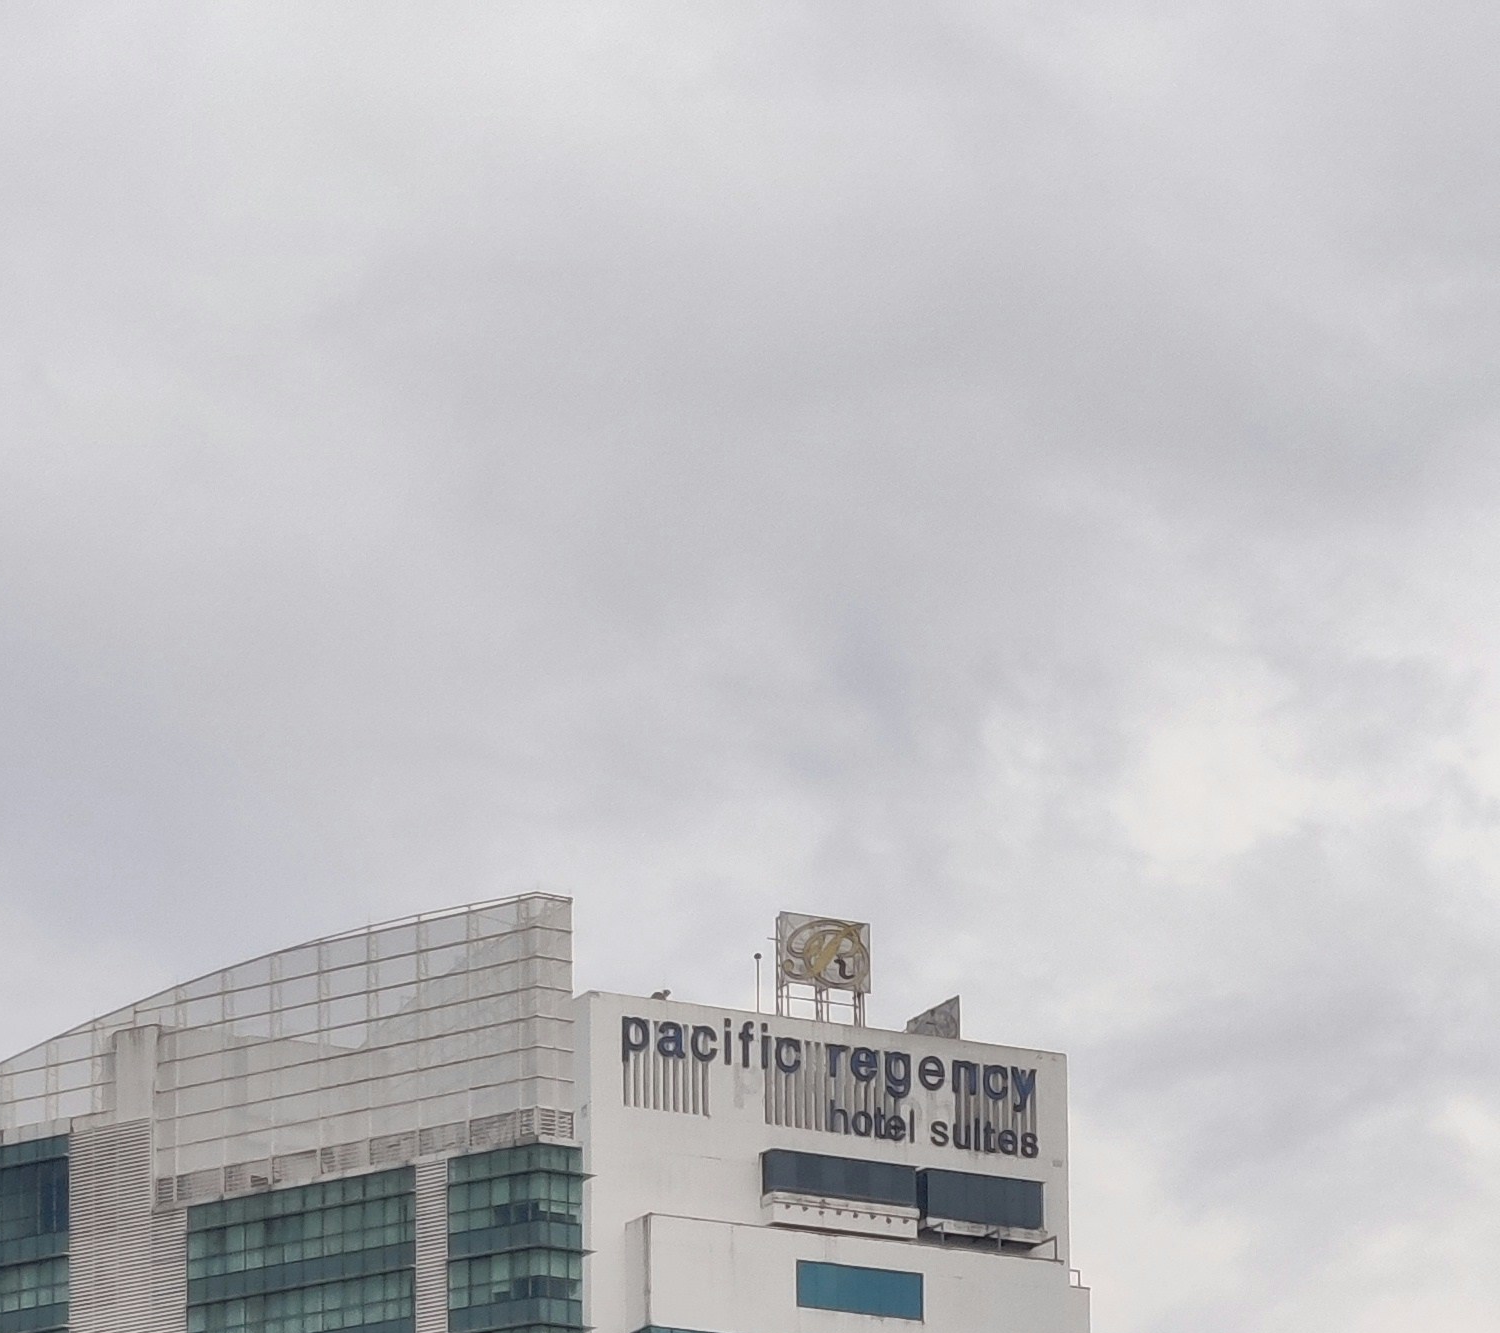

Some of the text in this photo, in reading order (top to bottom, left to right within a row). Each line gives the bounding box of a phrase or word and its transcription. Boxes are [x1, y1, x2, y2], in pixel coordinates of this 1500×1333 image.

[621, 1014, 1039, 1113] pacific regency
[828, 1098, 1040, 1159] hotel suites
